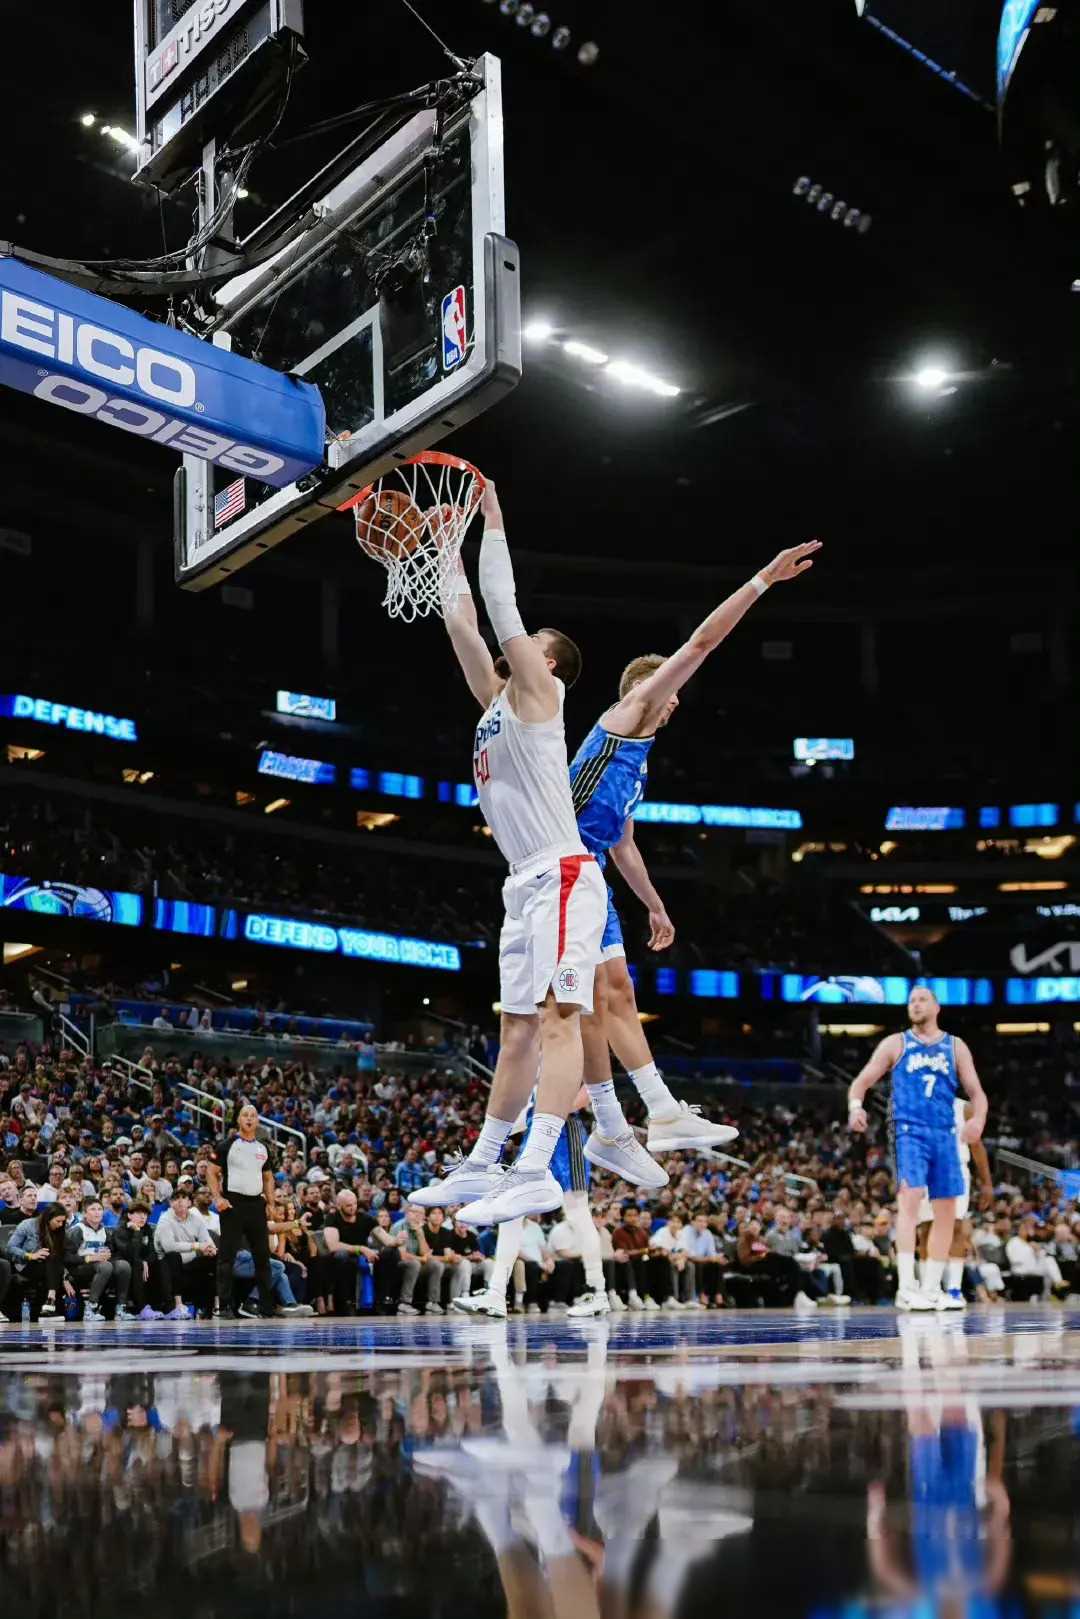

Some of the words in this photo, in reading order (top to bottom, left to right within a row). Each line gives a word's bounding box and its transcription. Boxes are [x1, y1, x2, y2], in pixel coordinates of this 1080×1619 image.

[33, 375, 286, 476] GEICO
[14, 694, 137, 741] DEFENSE
[246, 915, 338, 951] DEFEND
[338, 928, 400, 961] YOUR
[399, 936, 460, 971] HOME
[922, 1074, 936, 1098] 7
